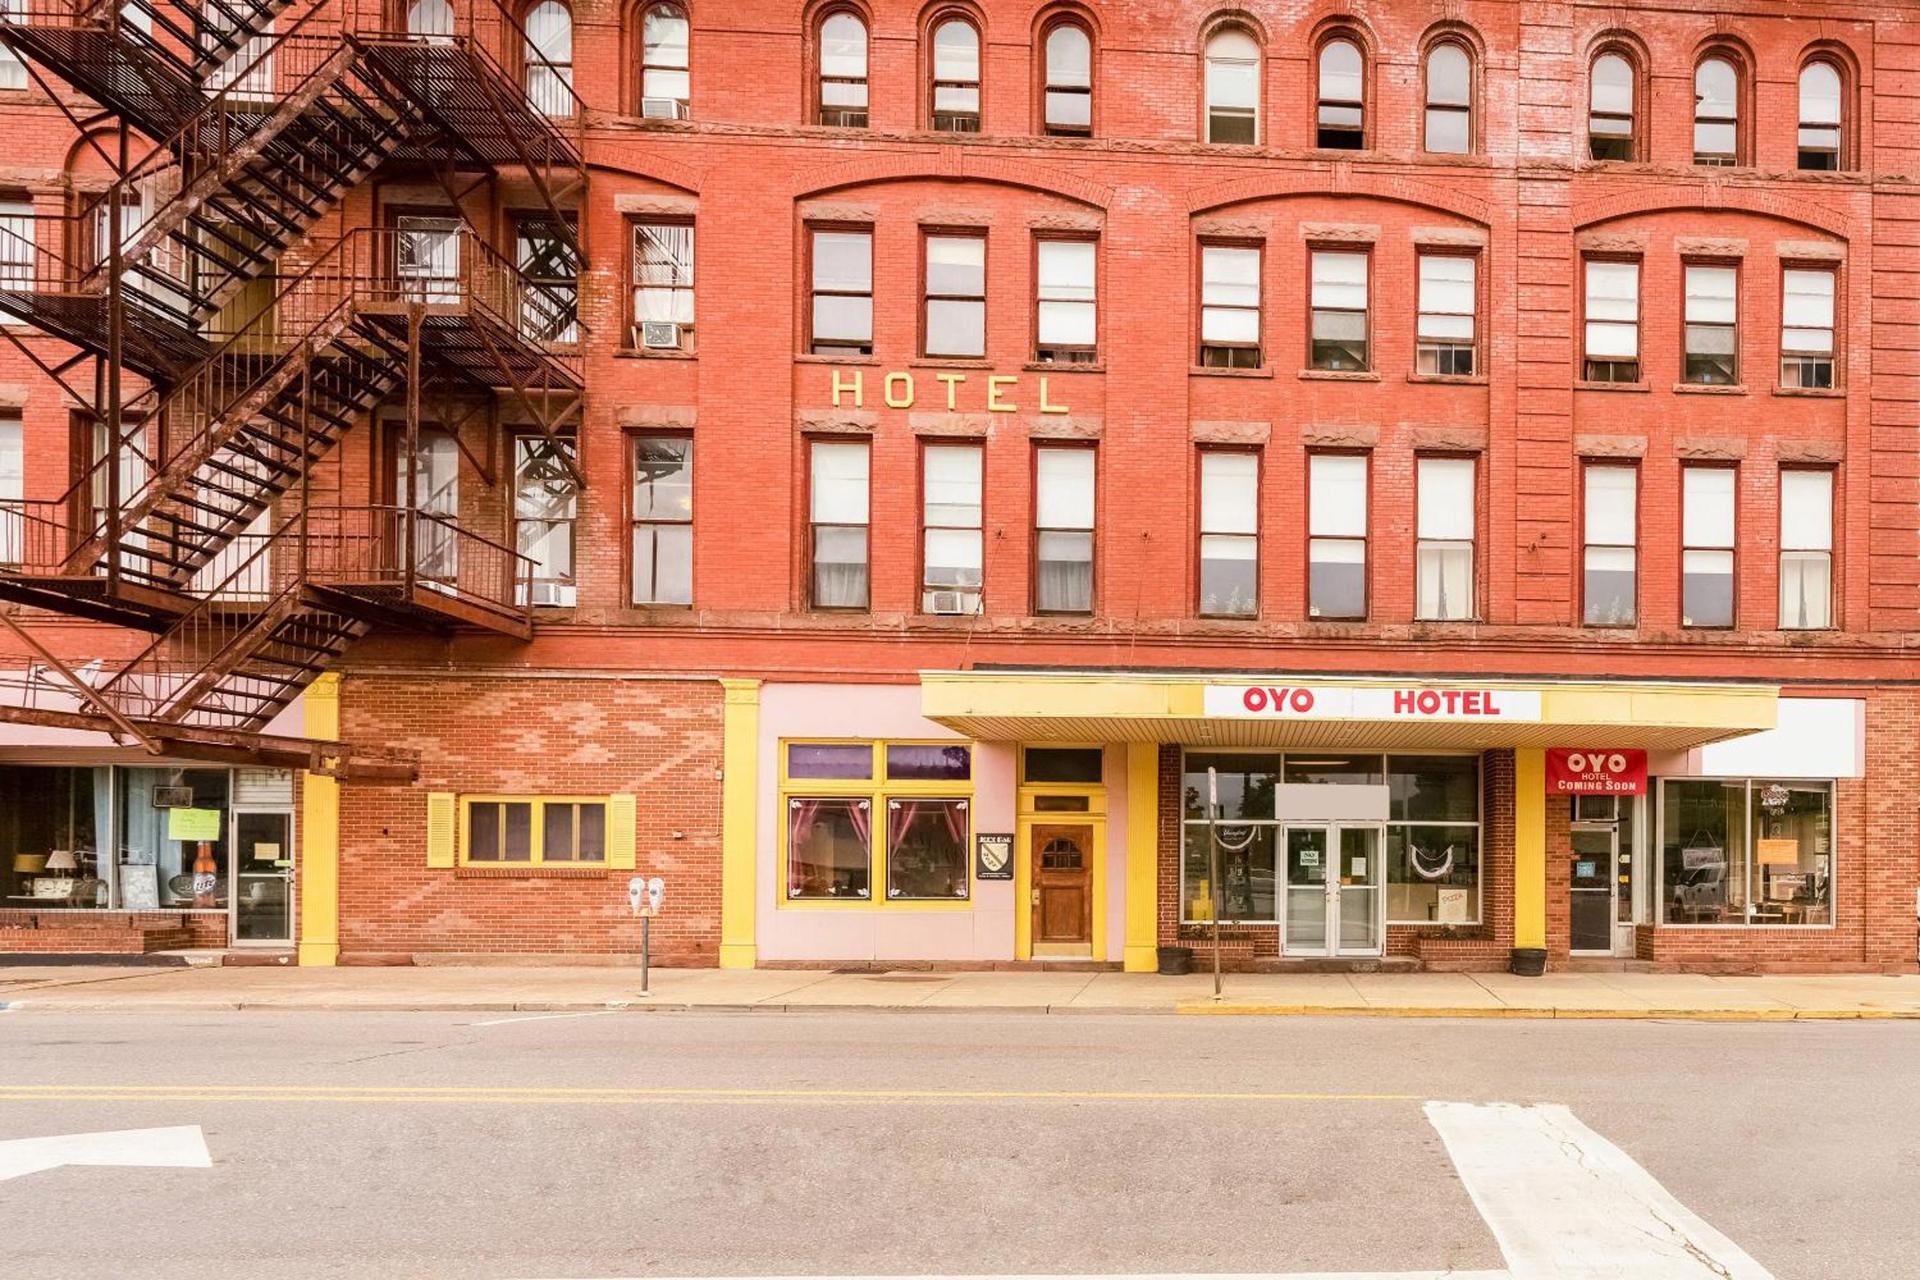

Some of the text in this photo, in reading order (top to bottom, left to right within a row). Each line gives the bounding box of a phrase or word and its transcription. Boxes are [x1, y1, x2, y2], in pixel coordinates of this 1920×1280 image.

[832, 370, 1070, 413] HOTEL
[1243, 687, 1501, 715] OYO HOTEL
[1567, 753, 1627, 773] OYO
[1581, 772, 1612, 781] HOTEL
